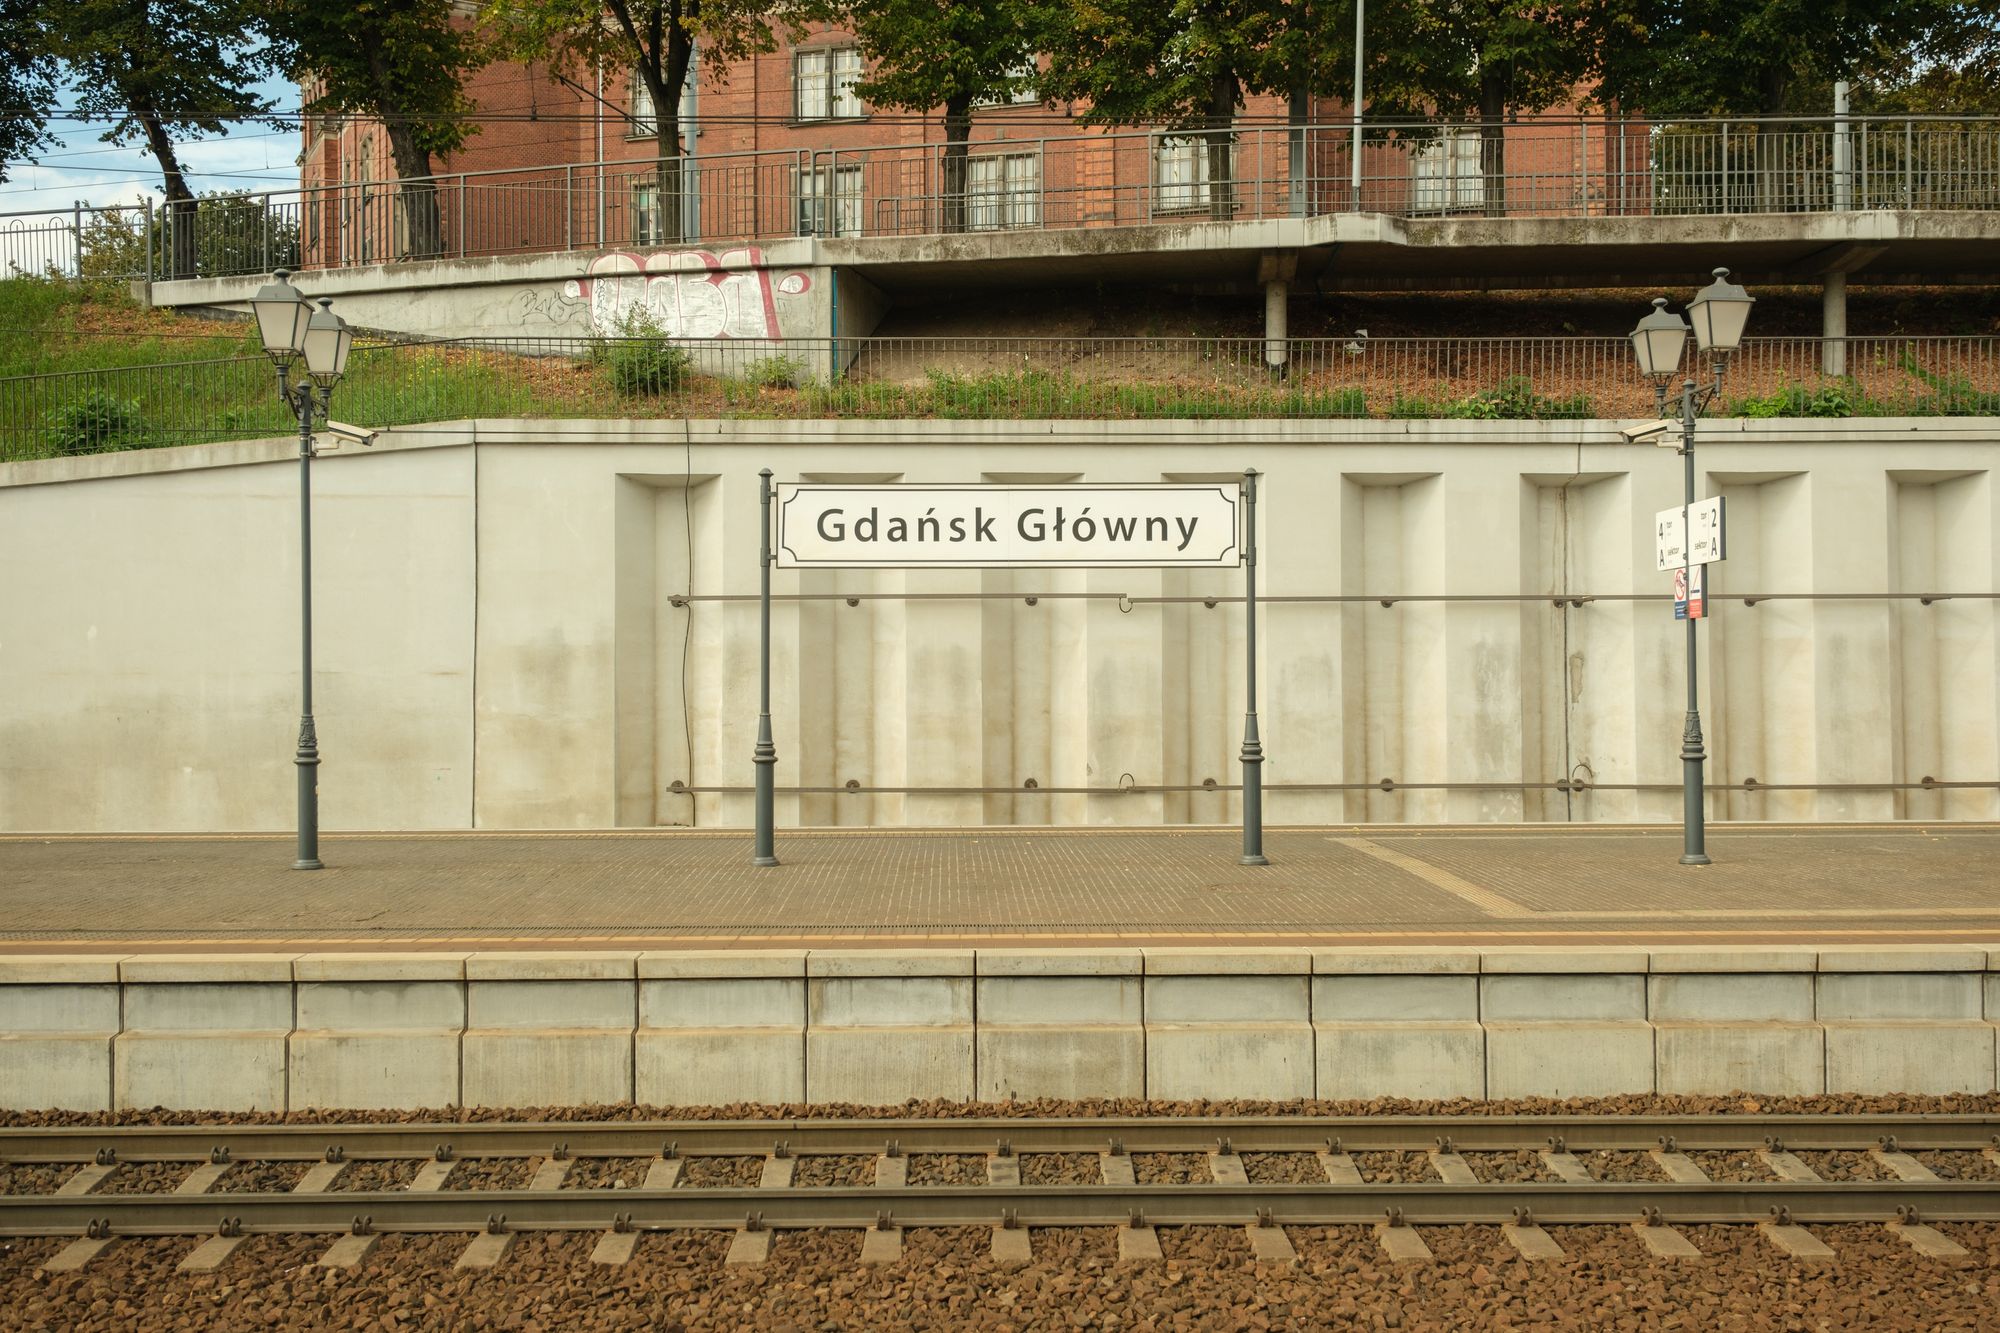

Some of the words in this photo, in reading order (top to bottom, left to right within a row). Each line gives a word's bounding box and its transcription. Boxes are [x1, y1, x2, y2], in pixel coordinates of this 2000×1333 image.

[1711, 508, 1717, 528] 2
[816, 507, 998, 543] Gdańsk
[1017, 506, 1199, 552] Główny
[1658, 522, 1664, 540] 4
[1711, 537, 1717, 556] A
[1660, 549, 1665, 567] A
